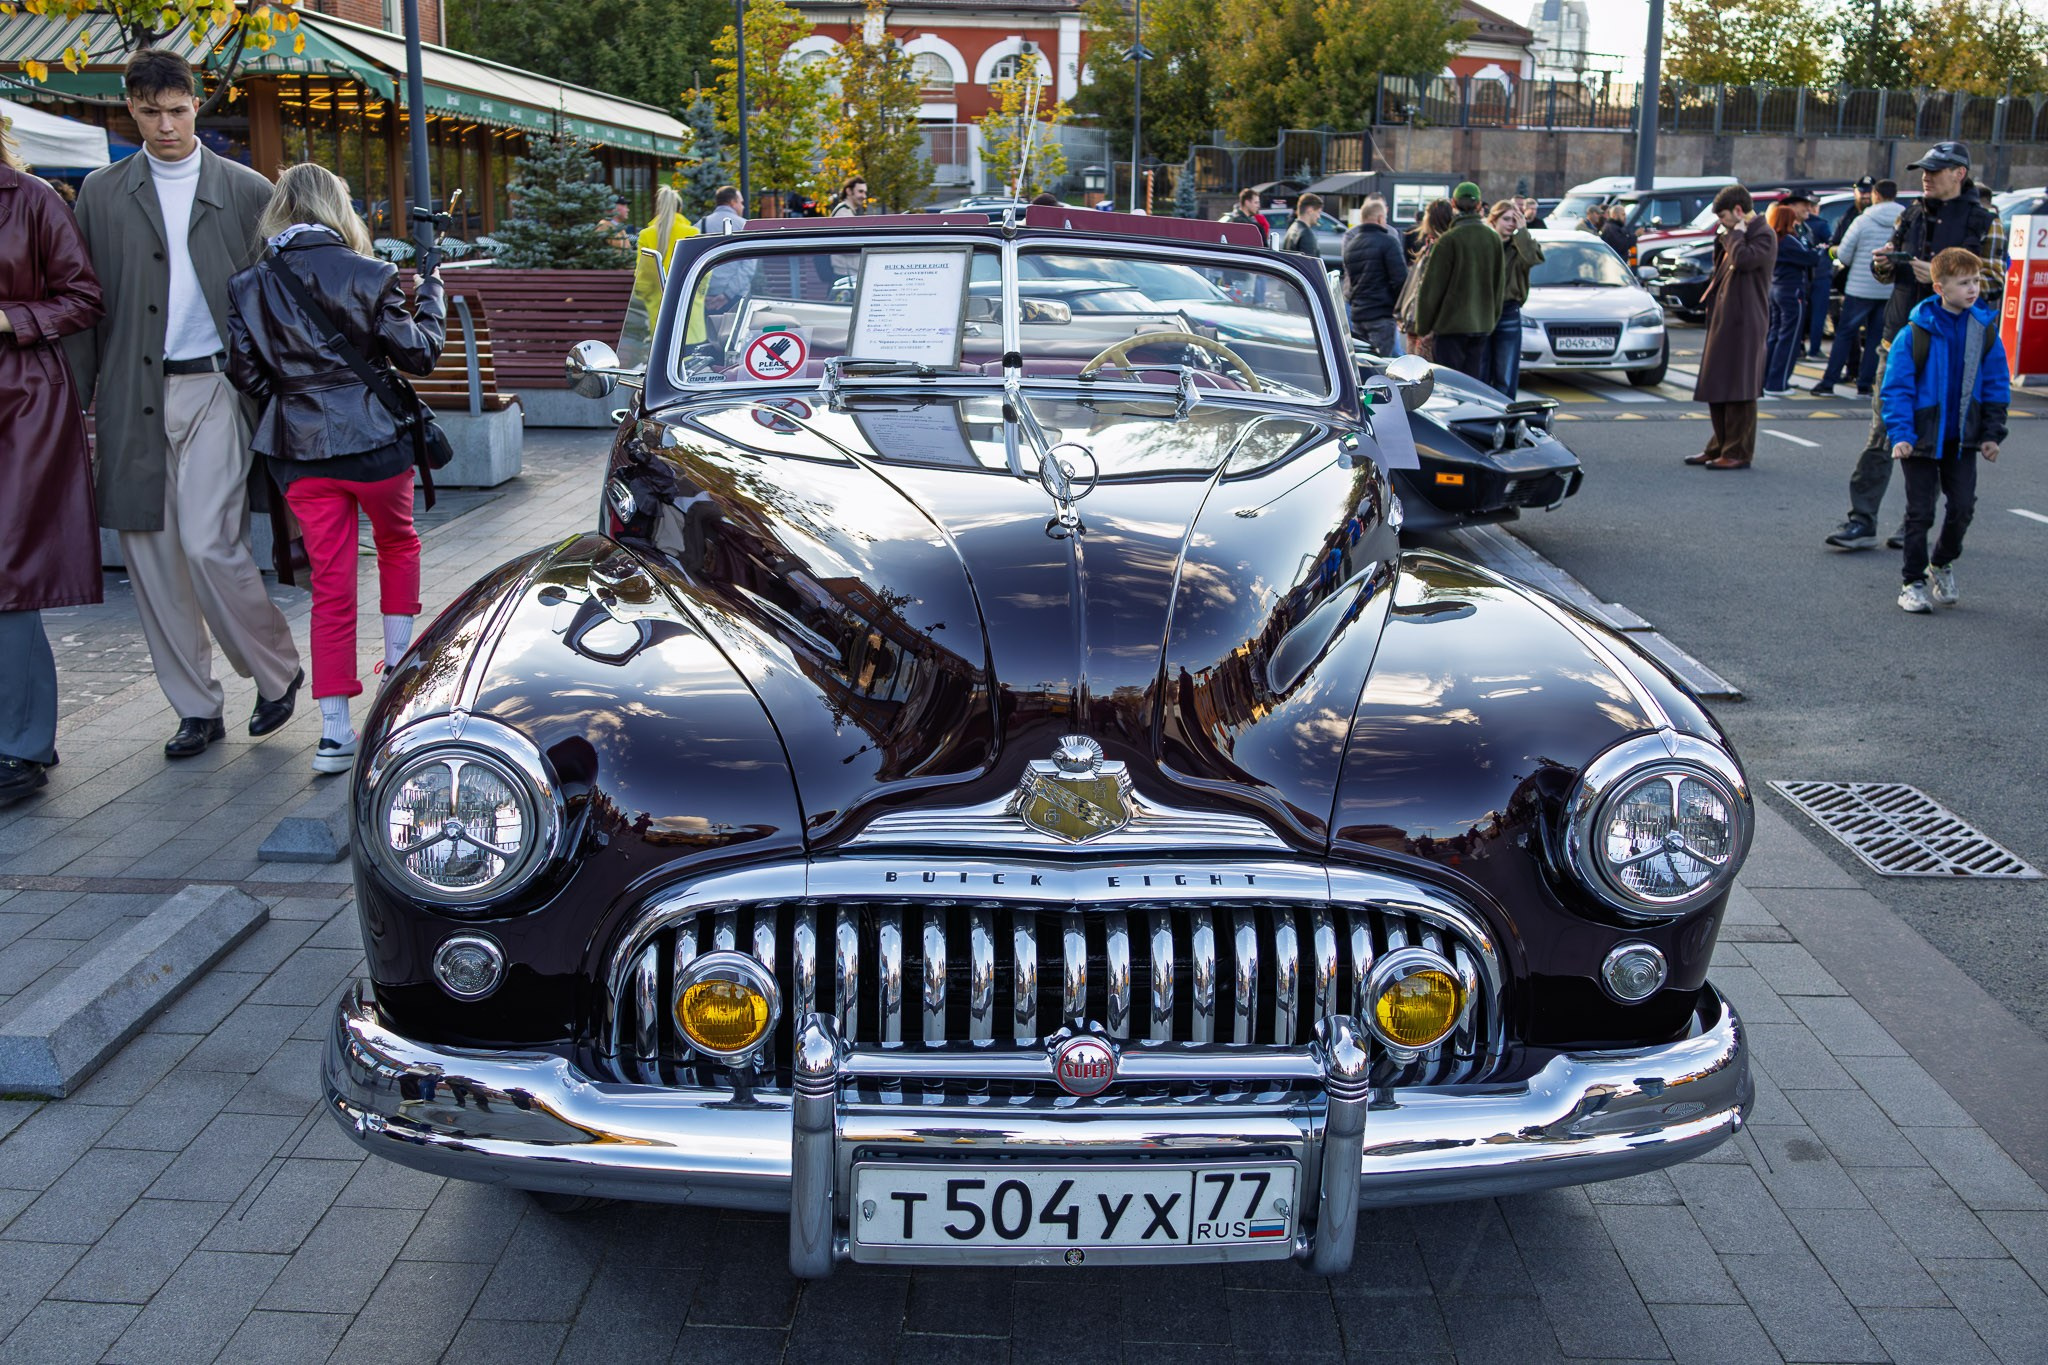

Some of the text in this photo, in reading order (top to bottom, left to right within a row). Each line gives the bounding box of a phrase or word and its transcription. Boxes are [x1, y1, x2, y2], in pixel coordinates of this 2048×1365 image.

[0, 75, 35, 89] eraki
[2036, 228, 2048, 248] 2
[885, 871, 1259, 888] BUICK EIGHT
[1064, 1063, 1108, 1079] SUPER
[1203, 1171, 1272, 1221] 77
[1197, 1221, 1247, 1239] RUS
